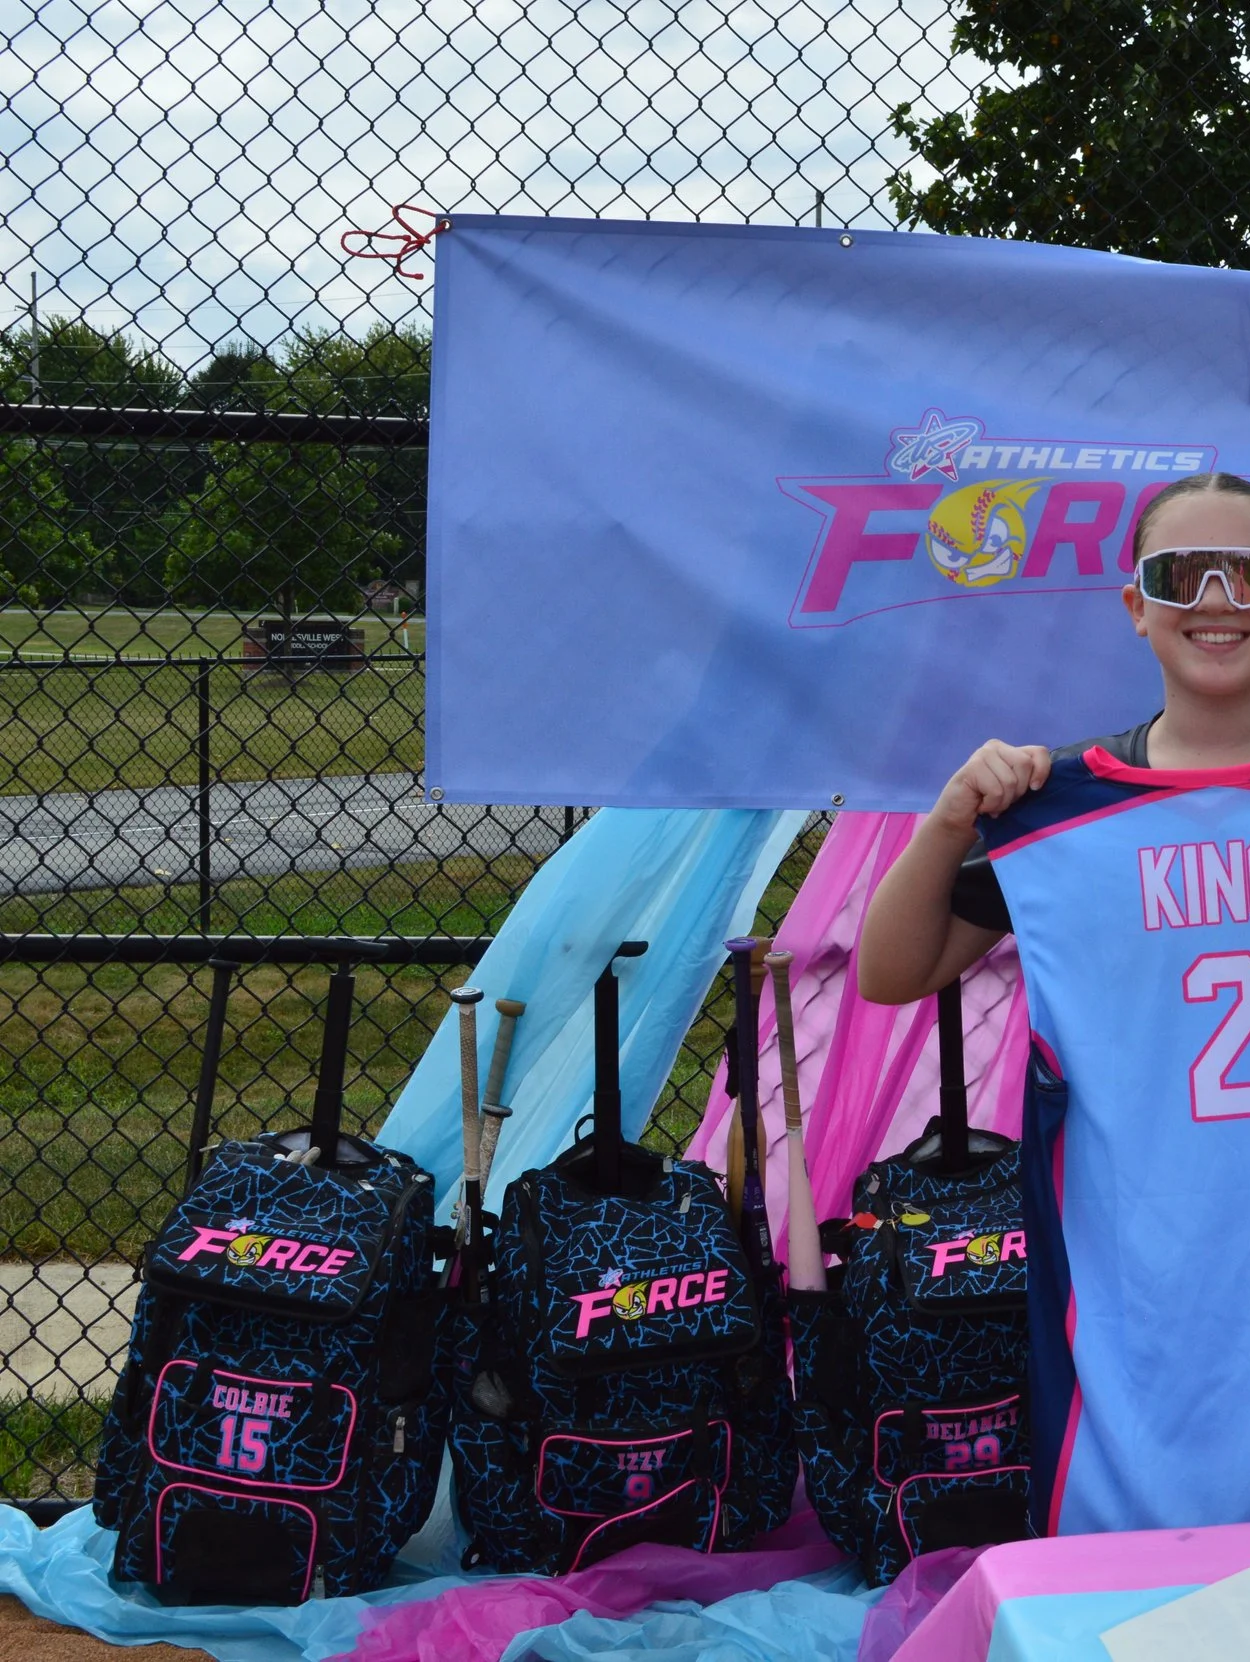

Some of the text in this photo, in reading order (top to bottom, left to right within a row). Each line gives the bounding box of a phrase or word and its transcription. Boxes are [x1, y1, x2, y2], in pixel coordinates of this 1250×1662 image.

[958, 445, 1204, 472] ATHLETICS
[271, 633, 343, 641] NOSVILLE WES
[178, 1226, 355, 1276] FORCE
[247, 1224, 334, 1244] ATHLETICS
[925, 1228, 1028, 1277] FOR
[620, 1261, 702, 1283] ATHLETICS
[569, 1268, 728, 1339] FORCE
[212, 1384, 294, 1418] COLBIE
[926, 1407, 1019, 1441] DELANEY
[216, 1415, 273, 1473] 15
[617, 1448, 667, 1472] IZZY
[943, 1433, 1002, 1471] 29
